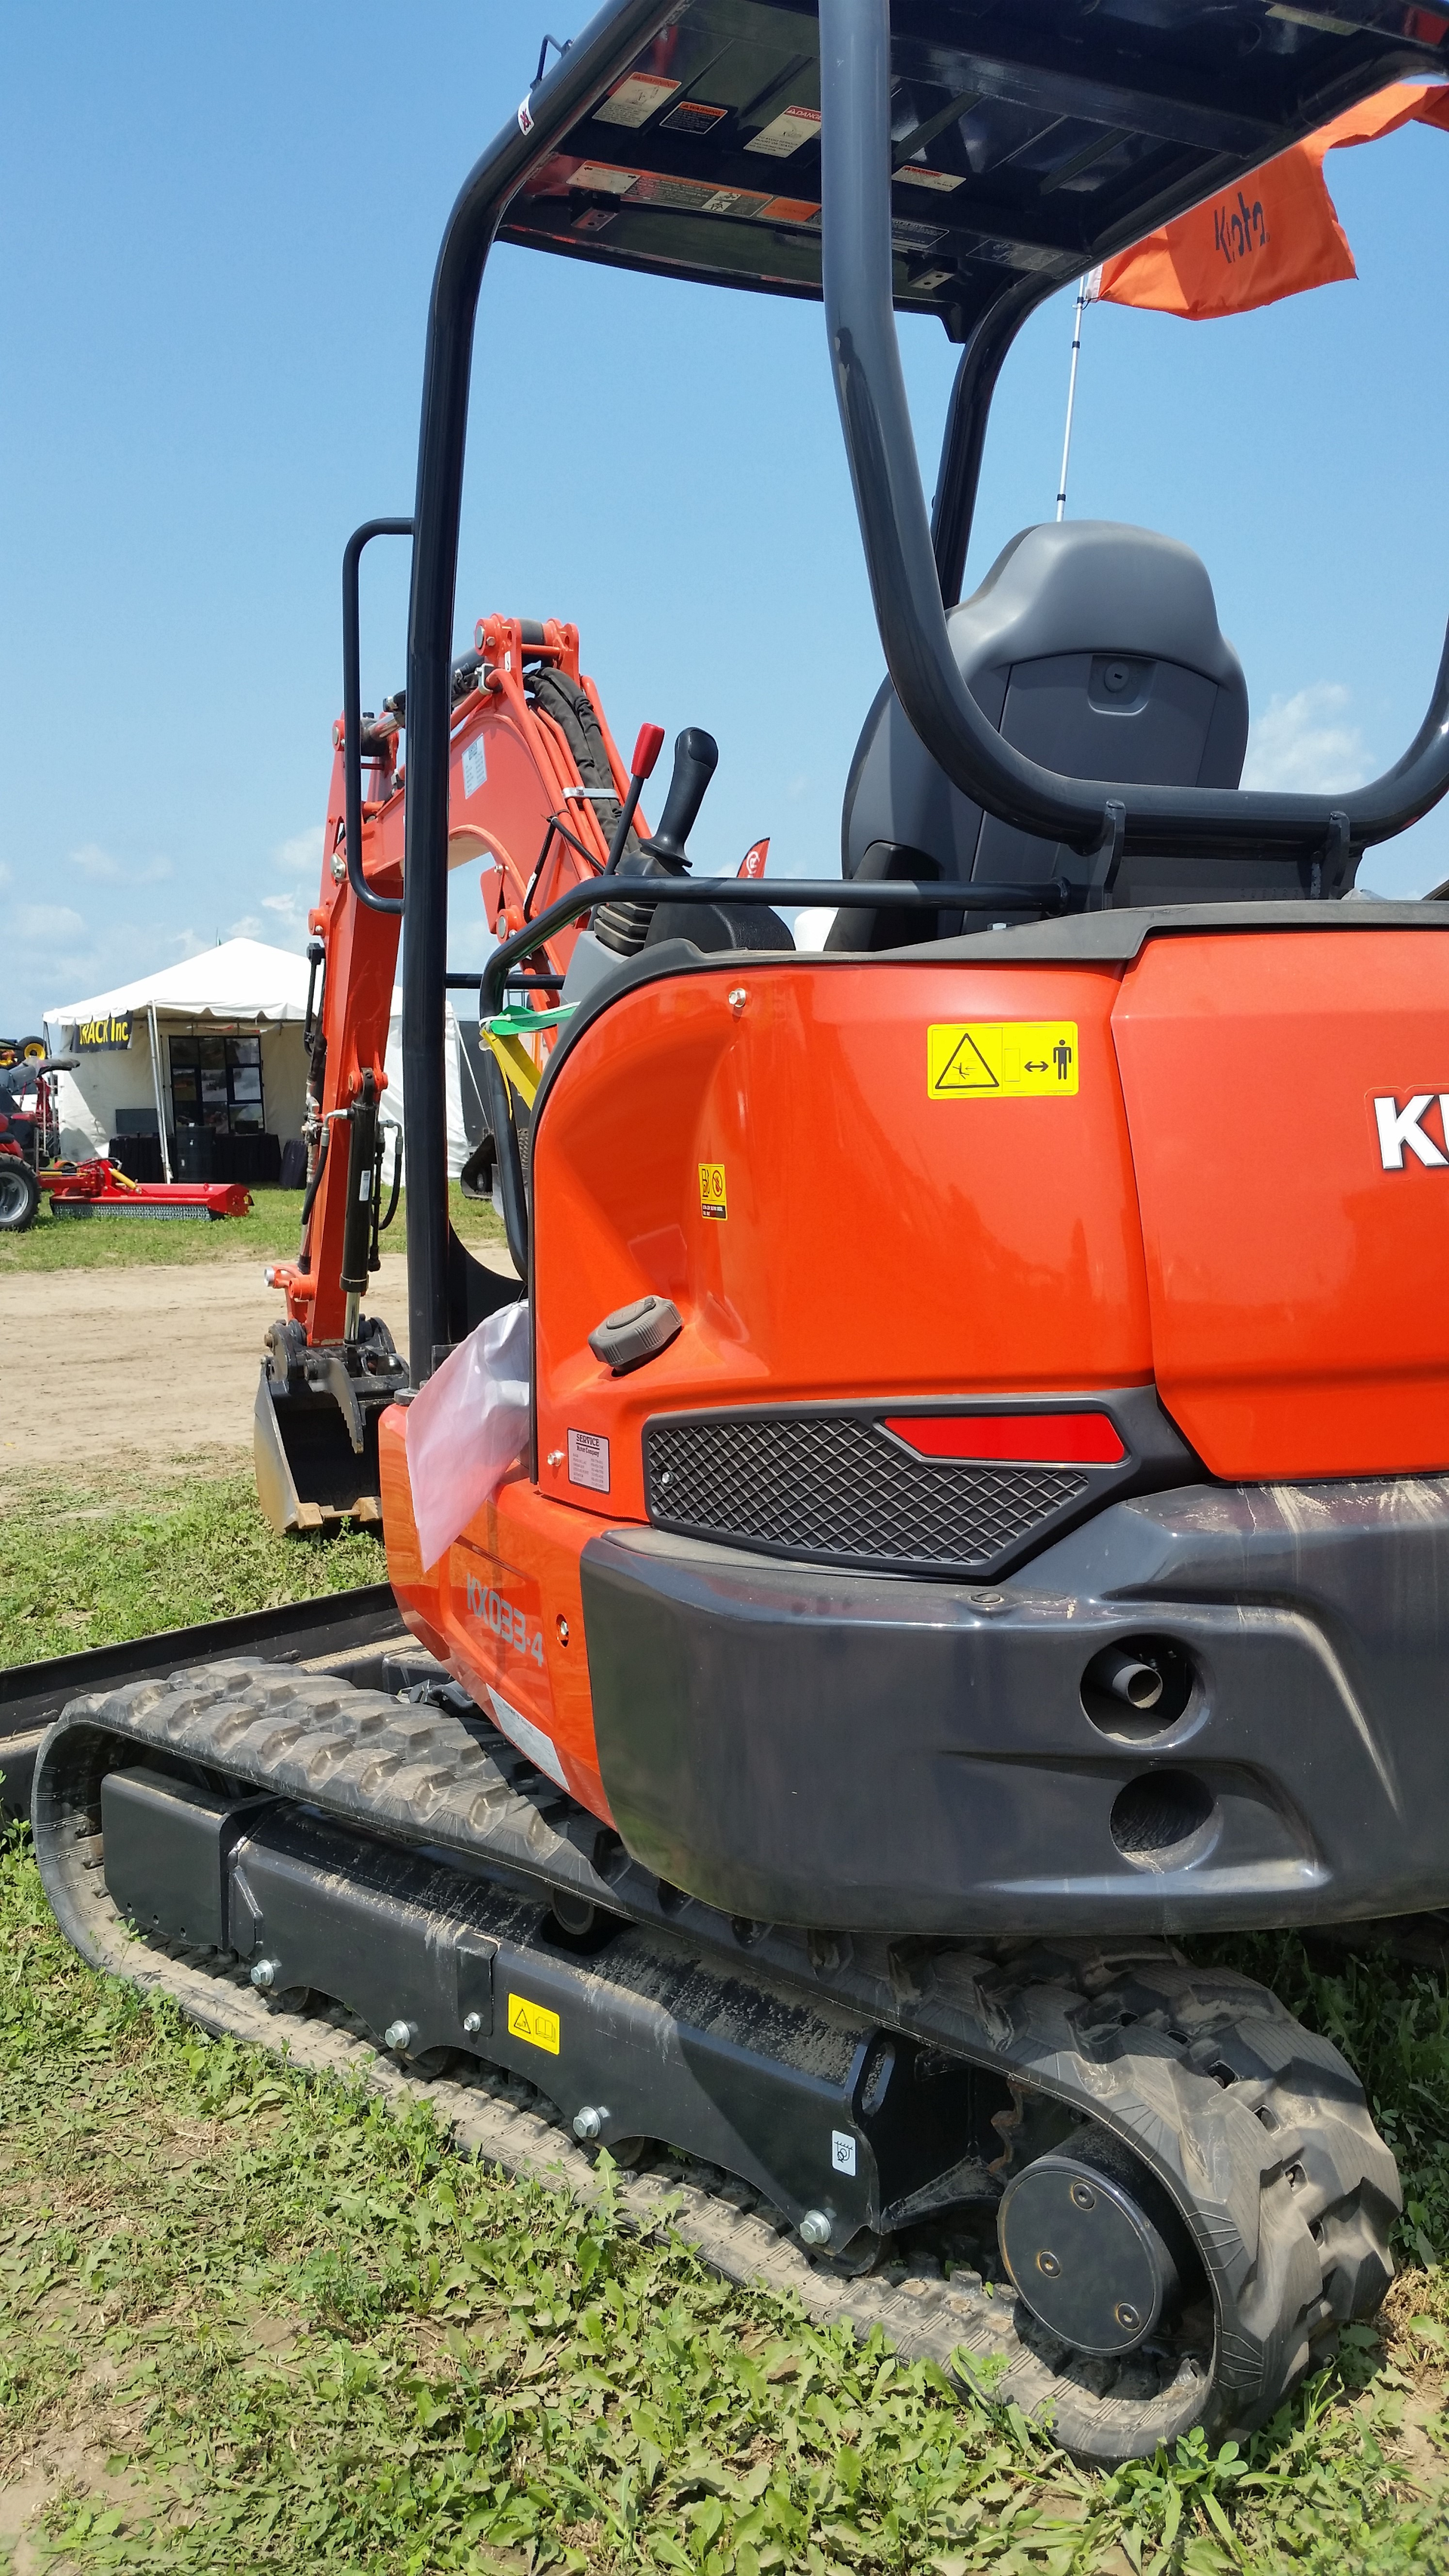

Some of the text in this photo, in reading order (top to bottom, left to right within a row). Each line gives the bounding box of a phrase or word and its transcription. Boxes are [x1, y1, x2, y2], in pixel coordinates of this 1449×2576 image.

[110, 1018, 129, 1042] Inc
[1374, 1094, 1449, 1169] K
[576, 1433, 600, 1448] SERVICE
[466, 1572, 543, 1667] KX033-4
